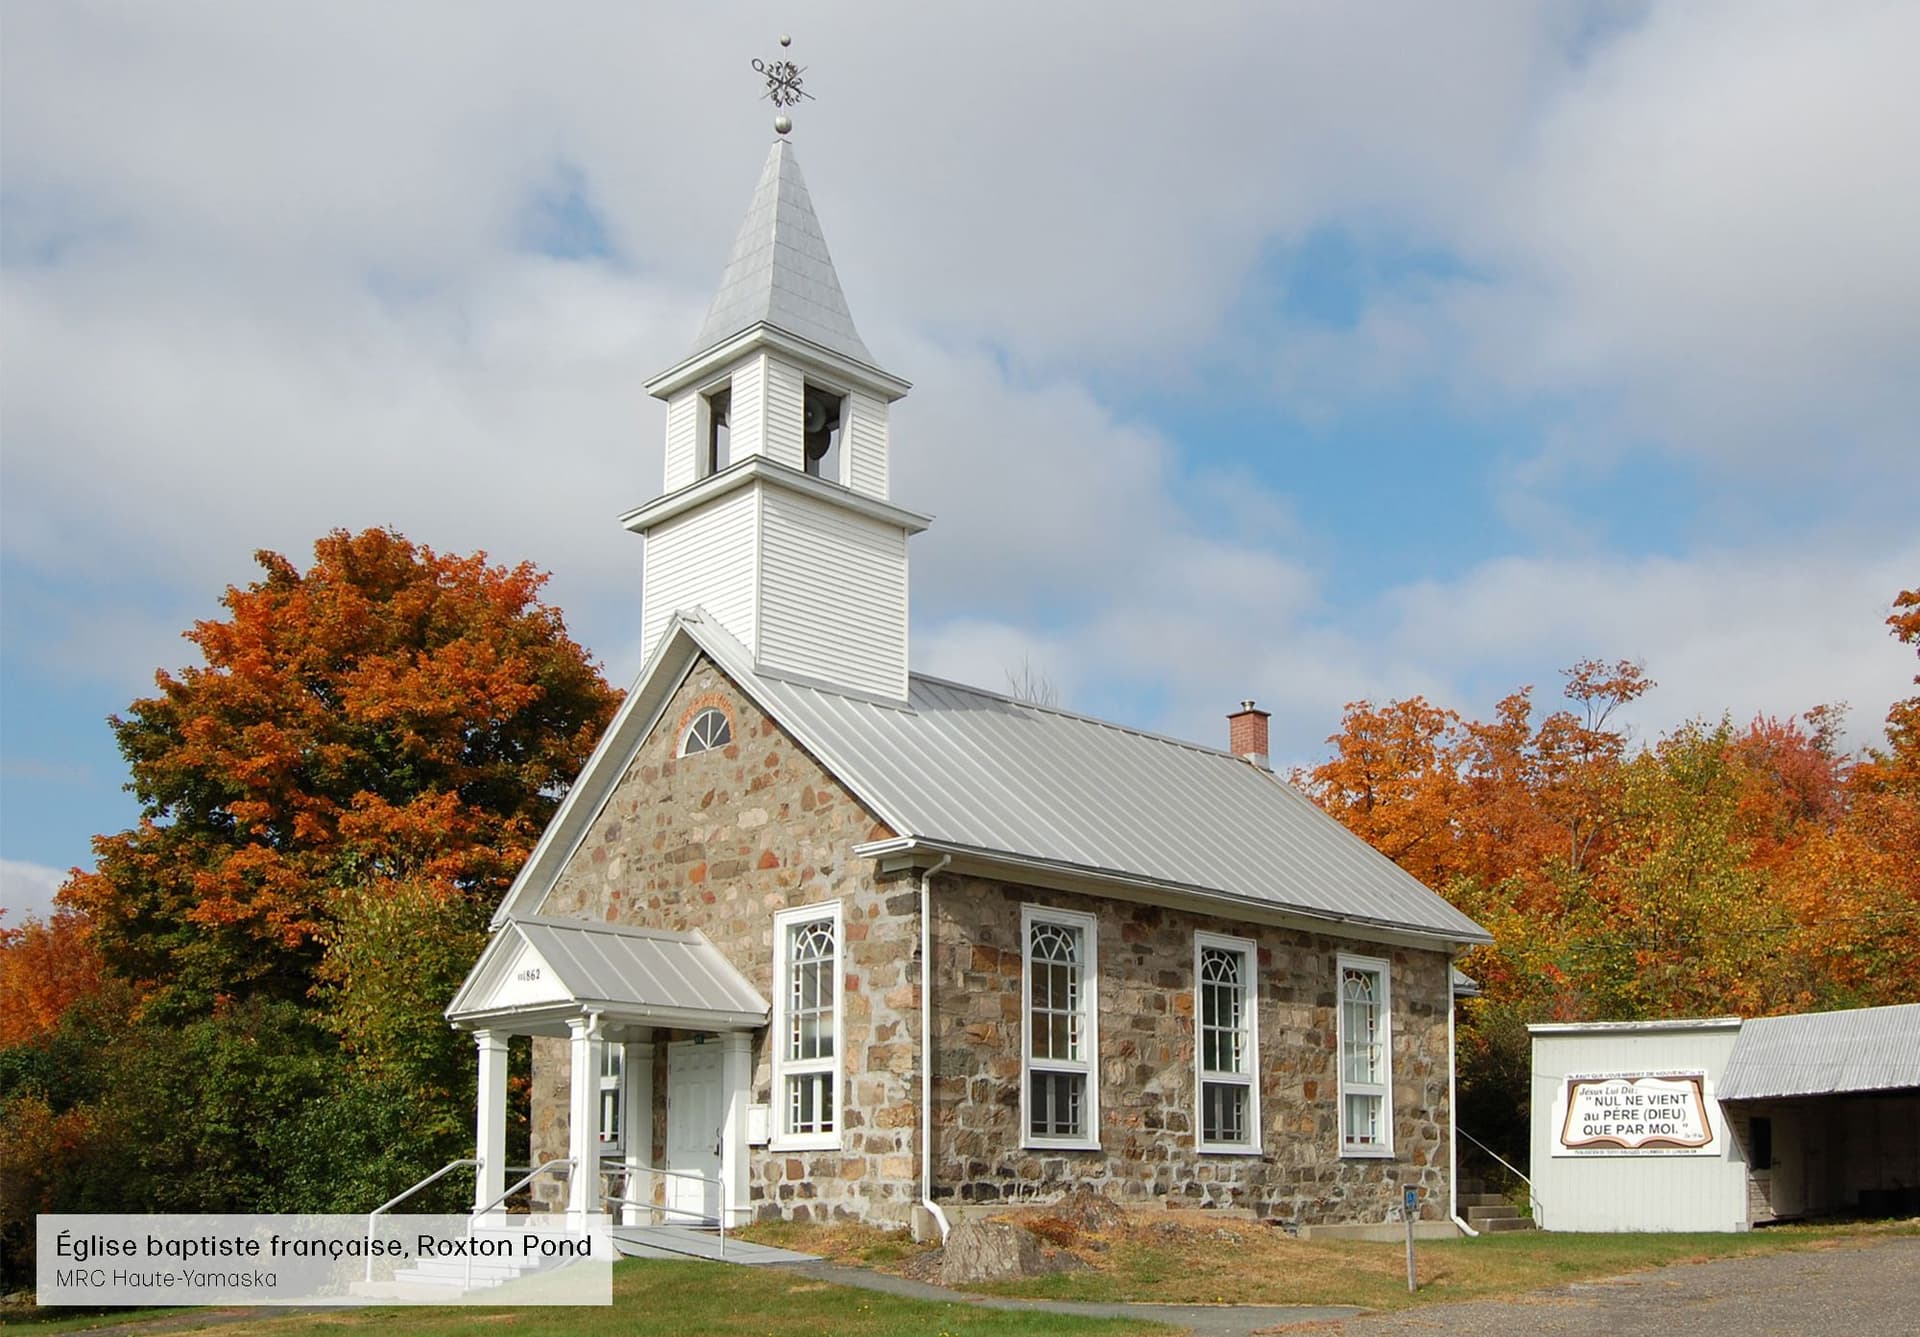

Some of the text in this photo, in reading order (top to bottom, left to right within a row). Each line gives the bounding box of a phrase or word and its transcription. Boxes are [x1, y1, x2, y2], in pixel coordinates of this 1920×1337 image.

[1625, 1095, 1644, 1106] NE
[1647, 1094, 1689, 1105] VIENT
[1583, 1112, 1600, 1121] au
[1643, 1108, 1687, 1122] (DIEU)
[1583, 1124, 1612, 1136] QUE
[1616, 1124, 1645, 1135] PAR
